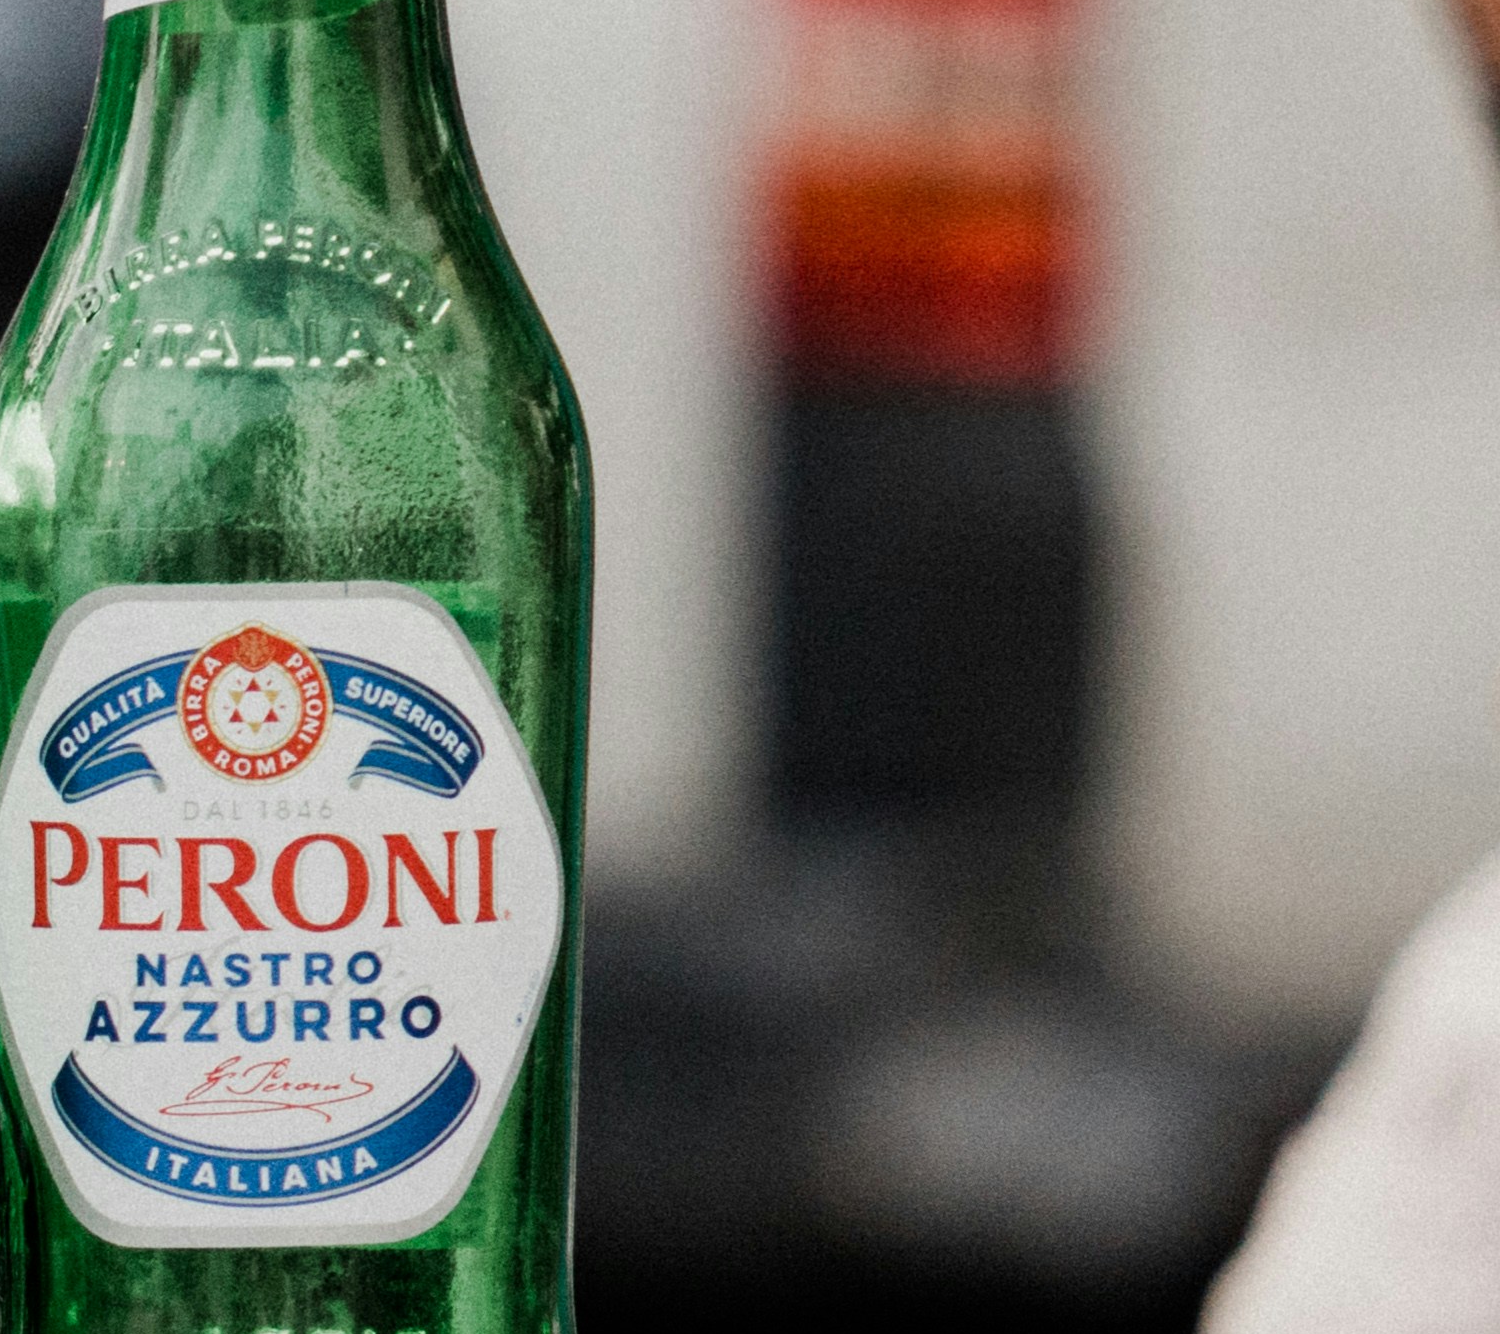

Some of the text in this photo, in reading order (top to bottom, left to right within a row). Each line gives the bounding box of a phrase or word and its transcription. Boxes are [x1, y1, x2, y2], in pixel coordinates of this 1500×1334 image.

[58, 677, 166, 759] QUALITÀ
[184, 652, 323, 746] BIRRA PERONI
[343, 676, 471, 766] SUPERIORE
[214, 750, 298, 778] ROMA
[183, 799, 334, 822] DAL 1846
[29, 820, 500, 932] PERONI
[136, 949, 384, 988] NASTRO
[84, 994, 443, 1044] AZZURRO
[145, 1146, 378, 1193] ITALIANA
